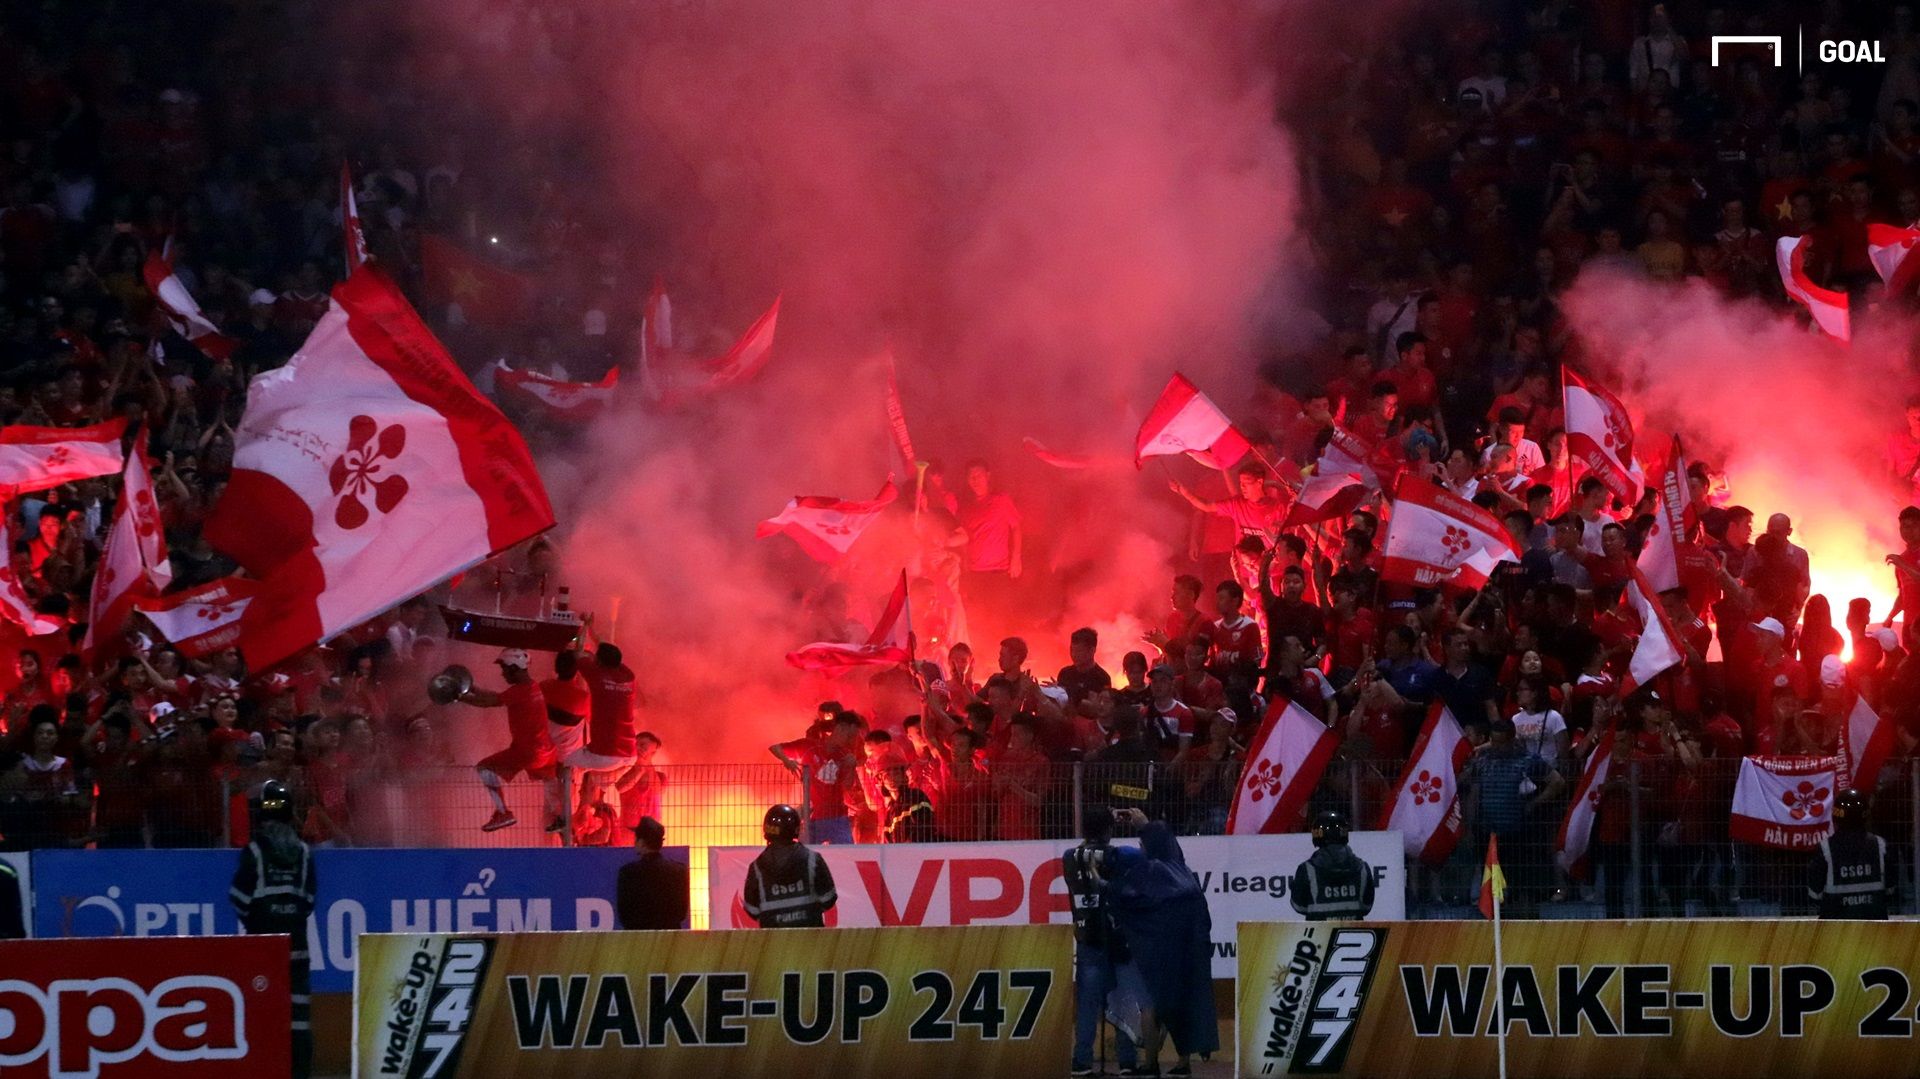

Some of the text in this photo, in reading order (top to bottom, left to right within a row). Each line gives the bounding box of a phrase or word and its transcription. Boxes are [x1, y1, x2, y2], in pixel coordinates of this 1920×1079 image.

[507, 970, 891, 1050] WAKE-UP
[908, 968, 1054, 1043] 247
[1400, 964, 1920, 1039] WAKE-UP 2
